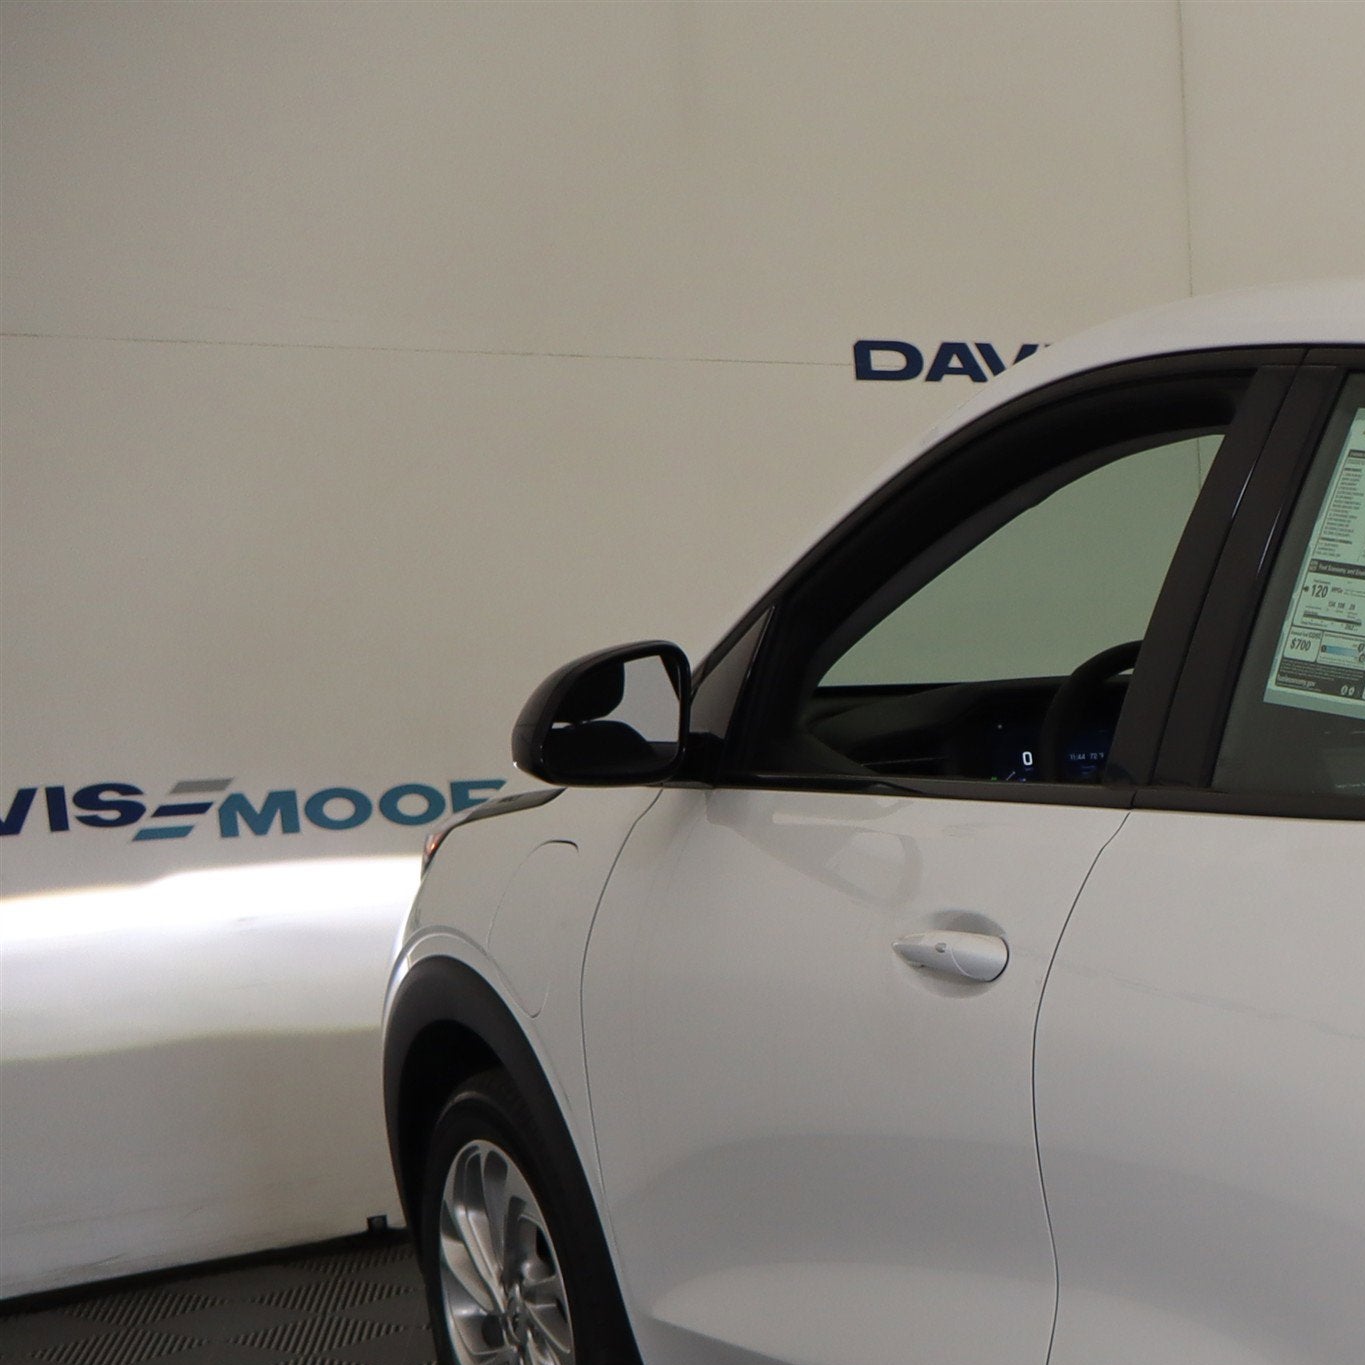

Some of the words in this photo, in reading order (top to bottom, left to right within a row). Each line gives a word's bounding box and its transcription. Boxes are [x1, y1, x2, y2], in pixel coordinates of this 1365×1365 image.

[853, 340, 1051, 382] DAV
[1311, 584, 1328, 598] 120
[1290, 638, 1311, 651] $700
[1022, 751, 1033, 766] 0
